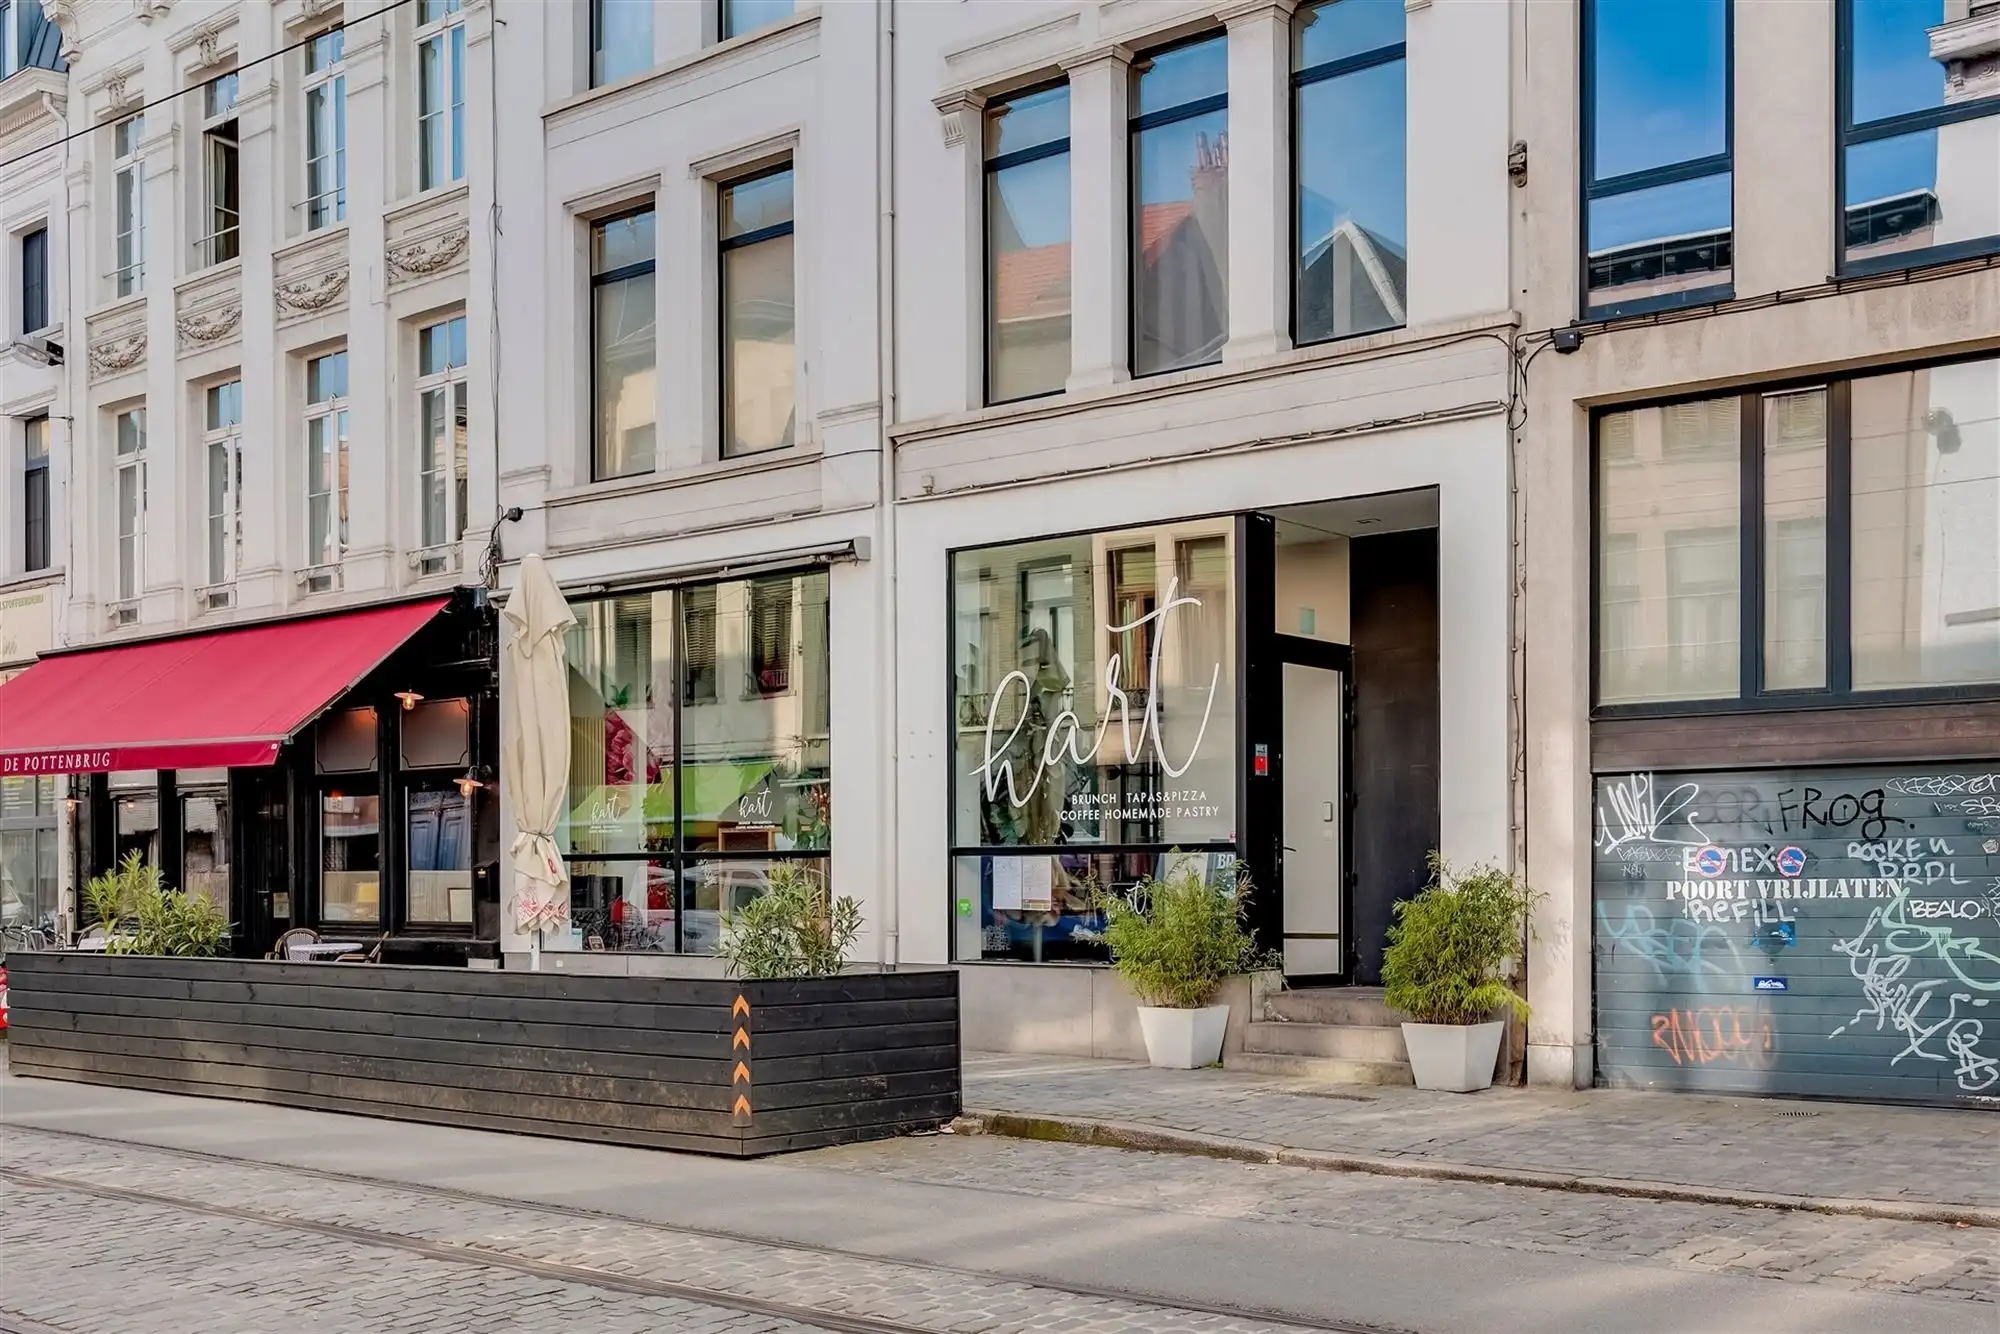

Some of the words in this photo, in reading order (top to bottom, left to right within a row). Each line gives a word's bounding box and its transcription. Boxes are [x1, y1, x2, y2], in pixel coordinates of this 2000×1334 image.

[968, 576, 1219, 808] hart
[4, 758, 19, 772] DE
[24, 752, 111, 771] POTTENBRUG
[738, 787, 773, 817] hart
[1071, 793, 1117, 805] BRUNCH
[1126, 790, 1207, 803] TAPAS&PIZZA
[1060, 809, 1100, 821] COFFEE
[1104, 807, 1172, 820] HOMEMADE
[1176, 806, 1220, 818] PASTRY
[1665, 880, 1750, 900] POORT
[1756, 878, 1904, 899] VRIJLATEN
